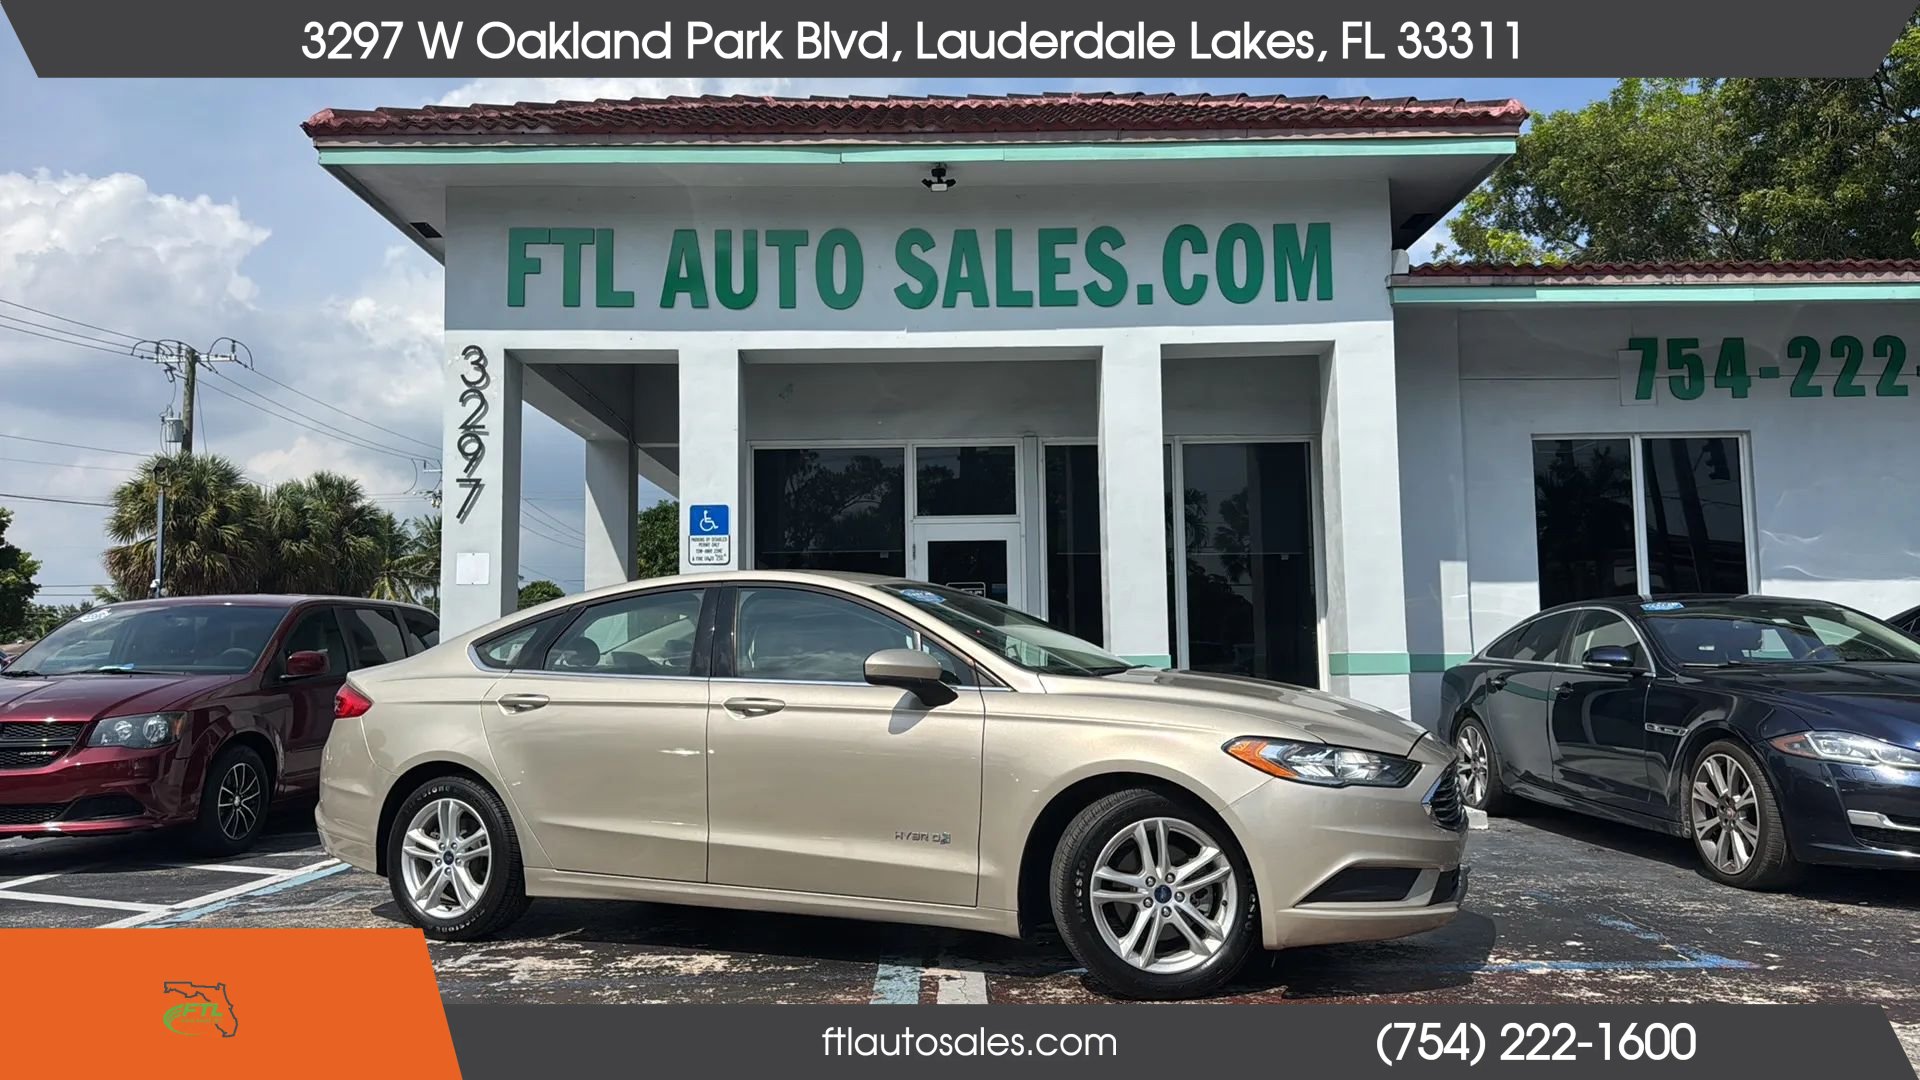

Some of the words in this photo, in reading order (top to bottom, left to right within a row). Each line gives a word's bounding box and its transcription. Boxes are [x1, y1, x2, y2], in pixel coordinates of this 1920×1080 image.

[507, 227, 637, 309] FTL
[658, 228, 866, 311] AUTO
[893, 222, 1336, 311] SALES.COM
[1628, 335, 1920, 401] 754-222
[455, 344, 490, 526] 3297
[894, 831, 941, 843] HYBRD
